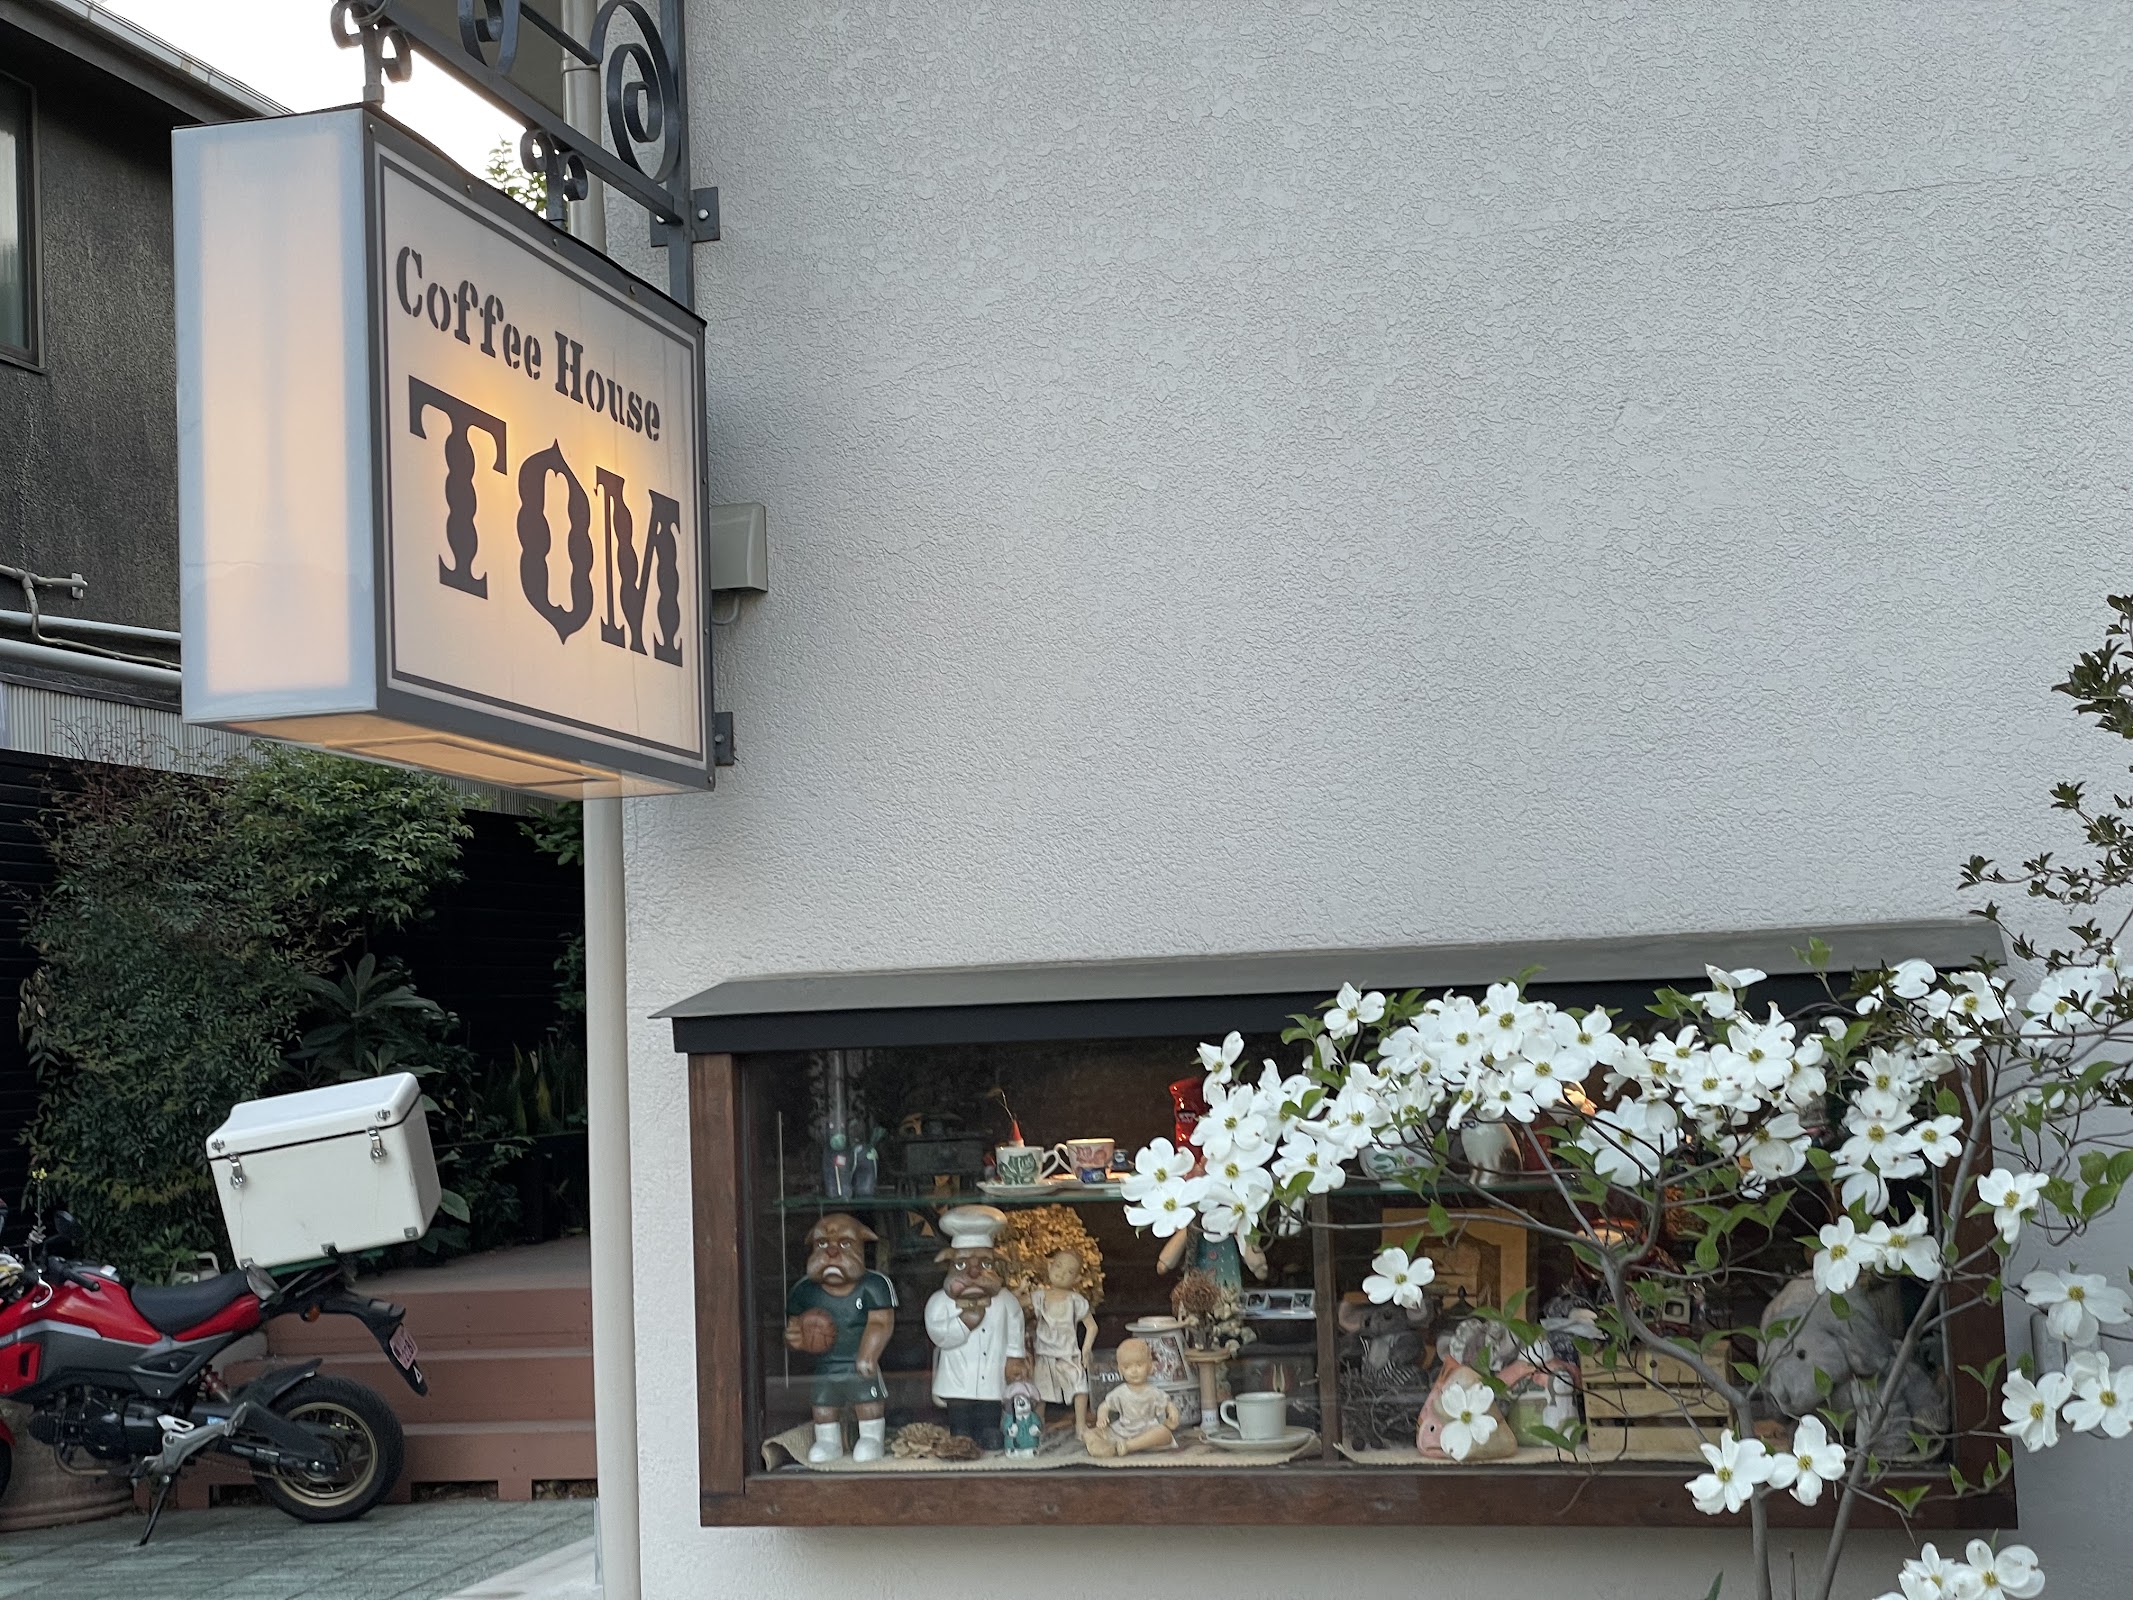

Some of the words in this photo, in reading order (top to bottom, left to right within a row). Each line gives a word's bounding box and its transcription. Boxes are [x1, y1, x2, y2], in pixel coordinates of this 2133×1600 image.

[396, 246, 542, 381] Coffee
[555, 330, 661, 442] House
[408, 374, 684, 668] TOM
